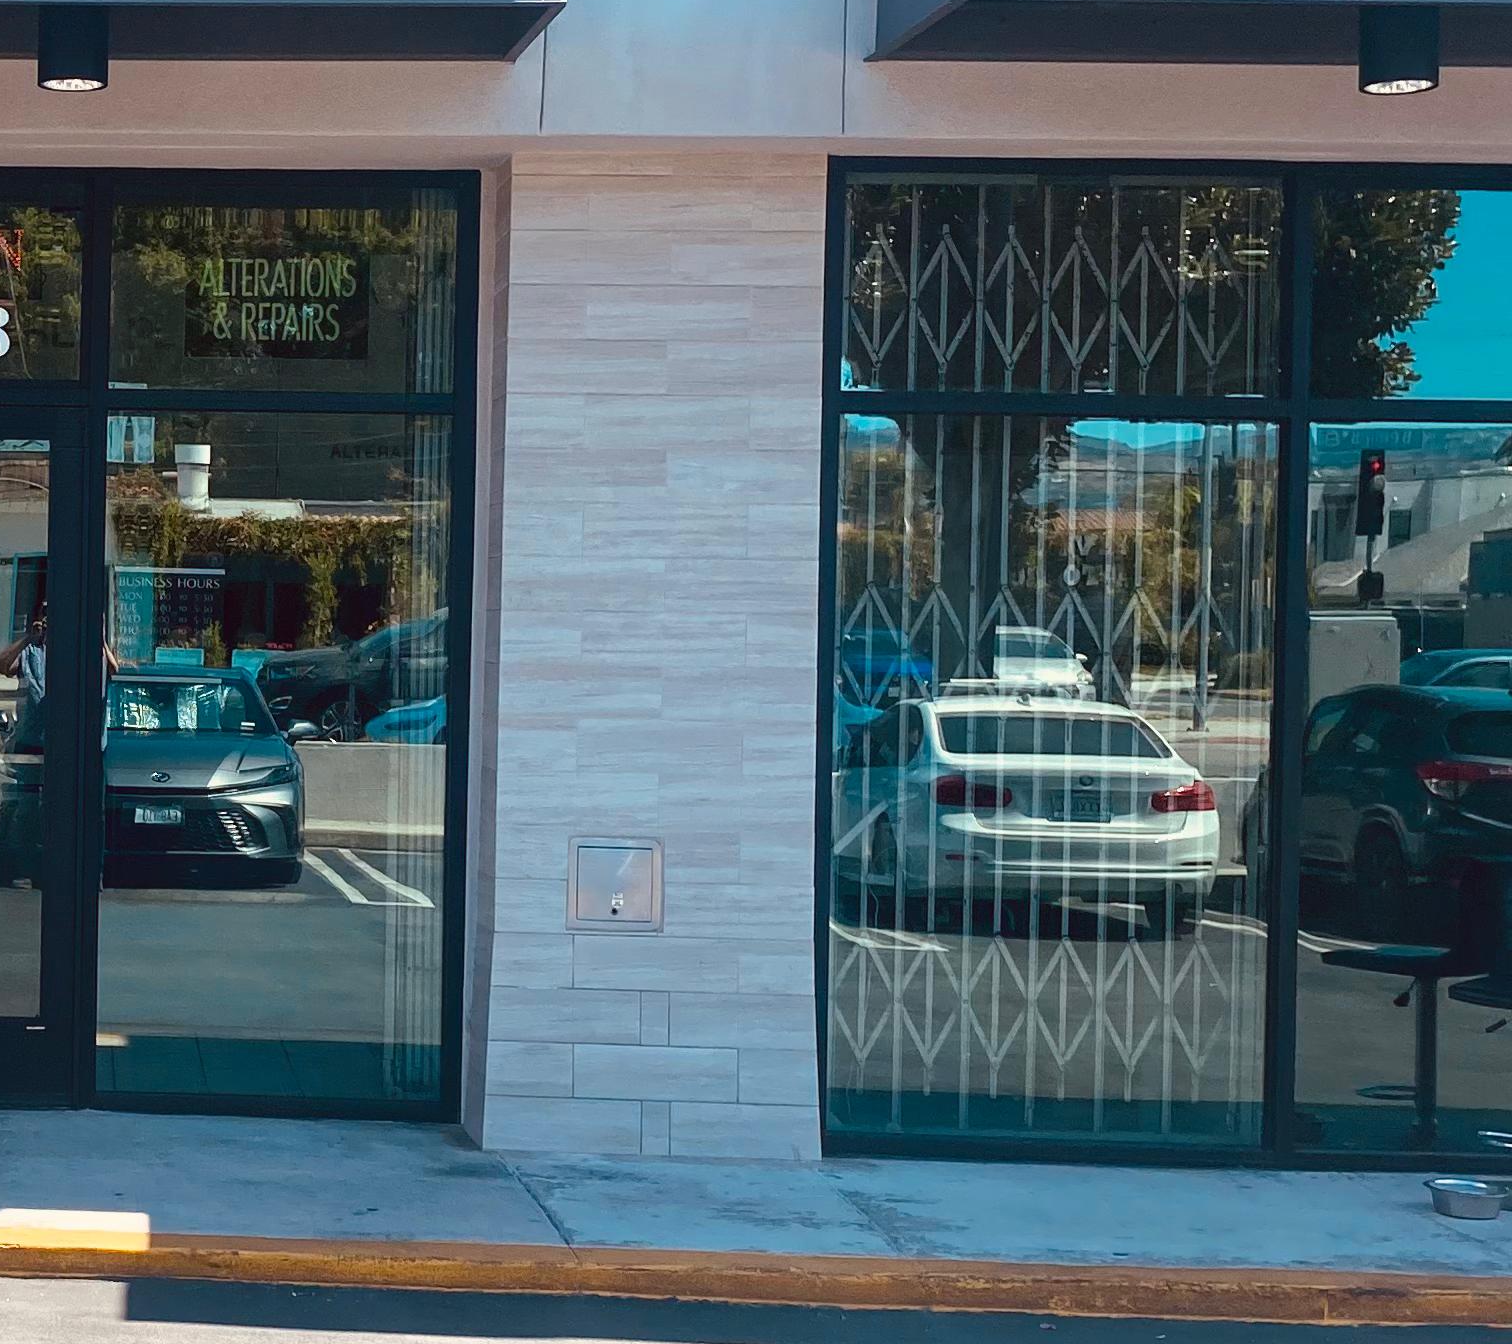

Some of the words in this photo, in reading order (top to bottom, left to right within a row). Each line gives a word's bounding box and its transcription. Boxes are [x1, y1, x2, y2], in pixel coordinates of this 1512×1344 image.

[198, 257, 357, 298] ALTERATIONS
[213, 302, 232, 340] &
[241, 302, 341, 342] REPAIRS
[119, 576, 173, 588] BUSINESS
[177, 577, 221, 589] HOURS
